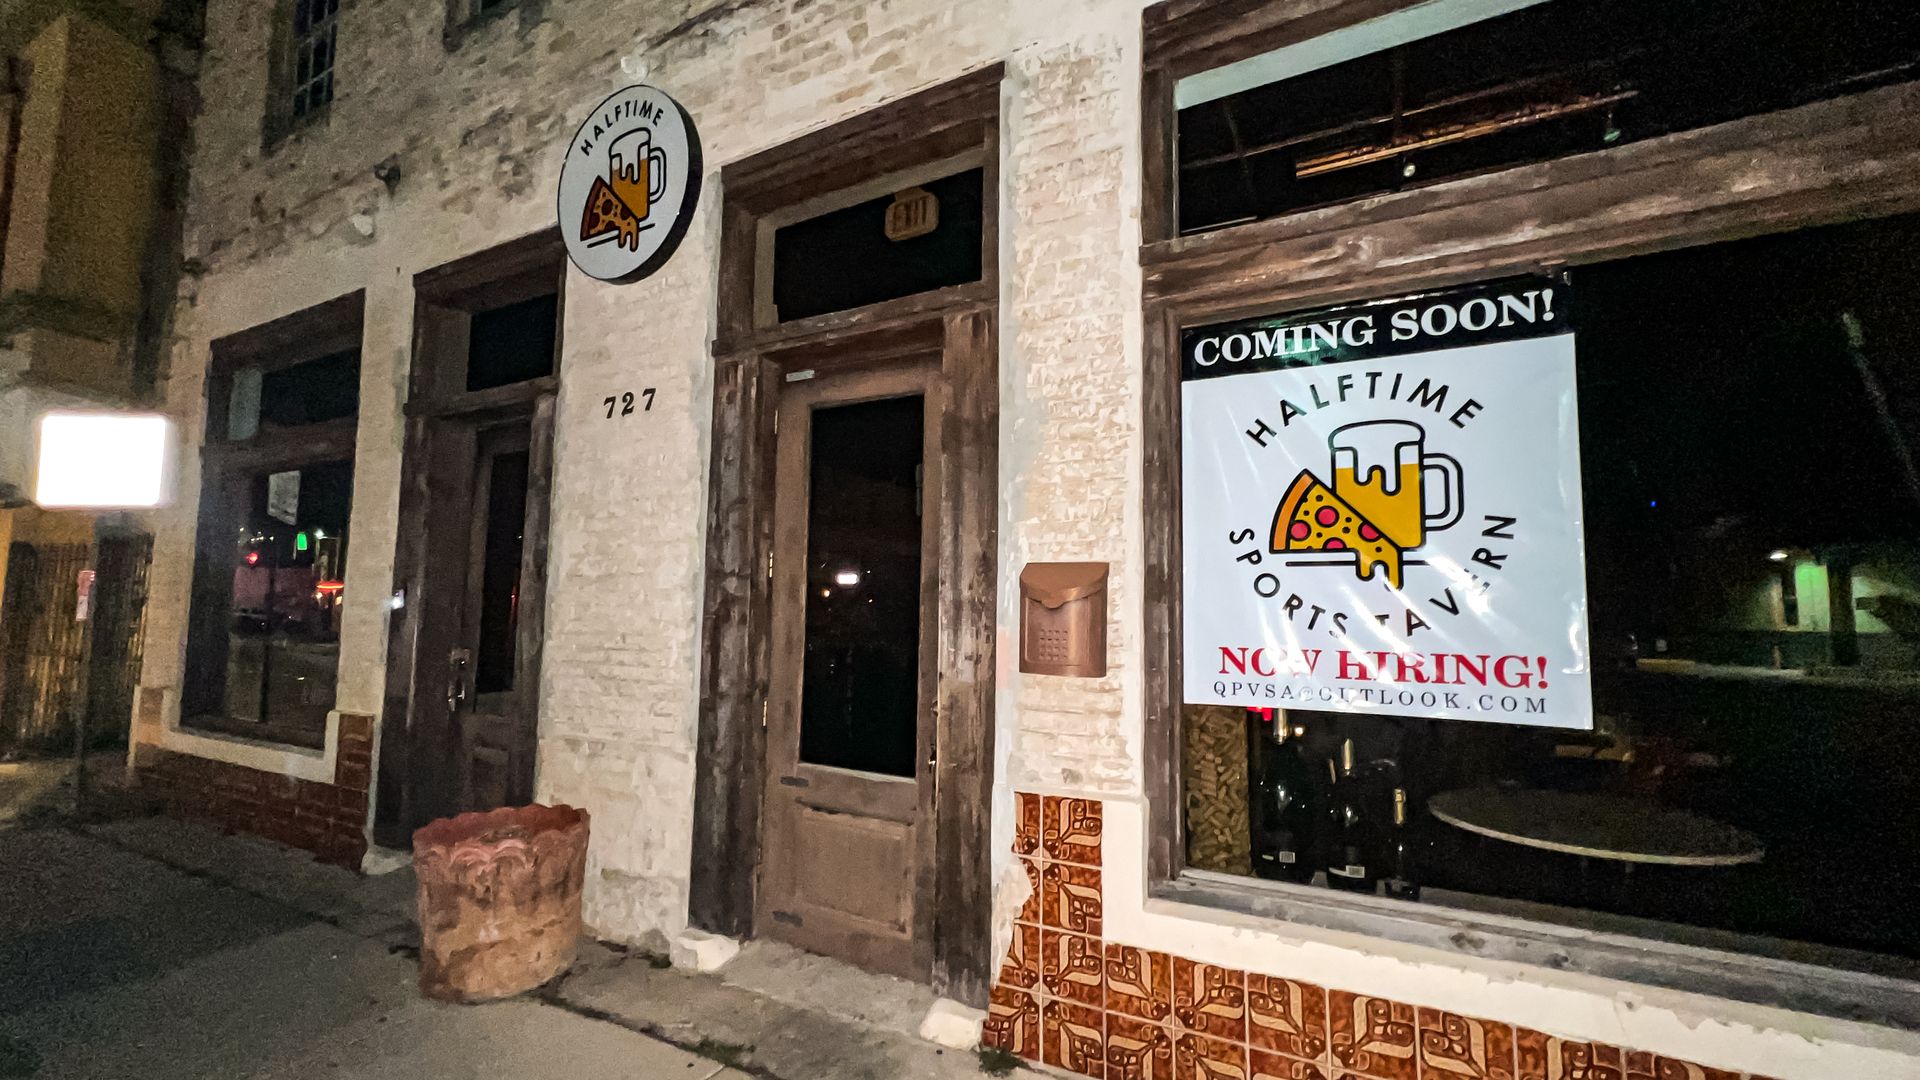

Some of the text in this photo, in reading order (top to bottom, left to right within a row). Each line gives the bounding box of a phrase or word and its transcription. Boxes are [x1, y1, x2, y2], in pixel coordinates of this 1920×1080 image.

[580, 99, 664, 156] HALFTIME
[1194, 289, 1555, 367] COMING SOON!
[603, 387, 656, 419] 727
[1245, 371, 1484, 448] HALFTIME
[1229, 528, 1349, 639] SPORTS
[1335, 649, 1549, 690] HIRING!
